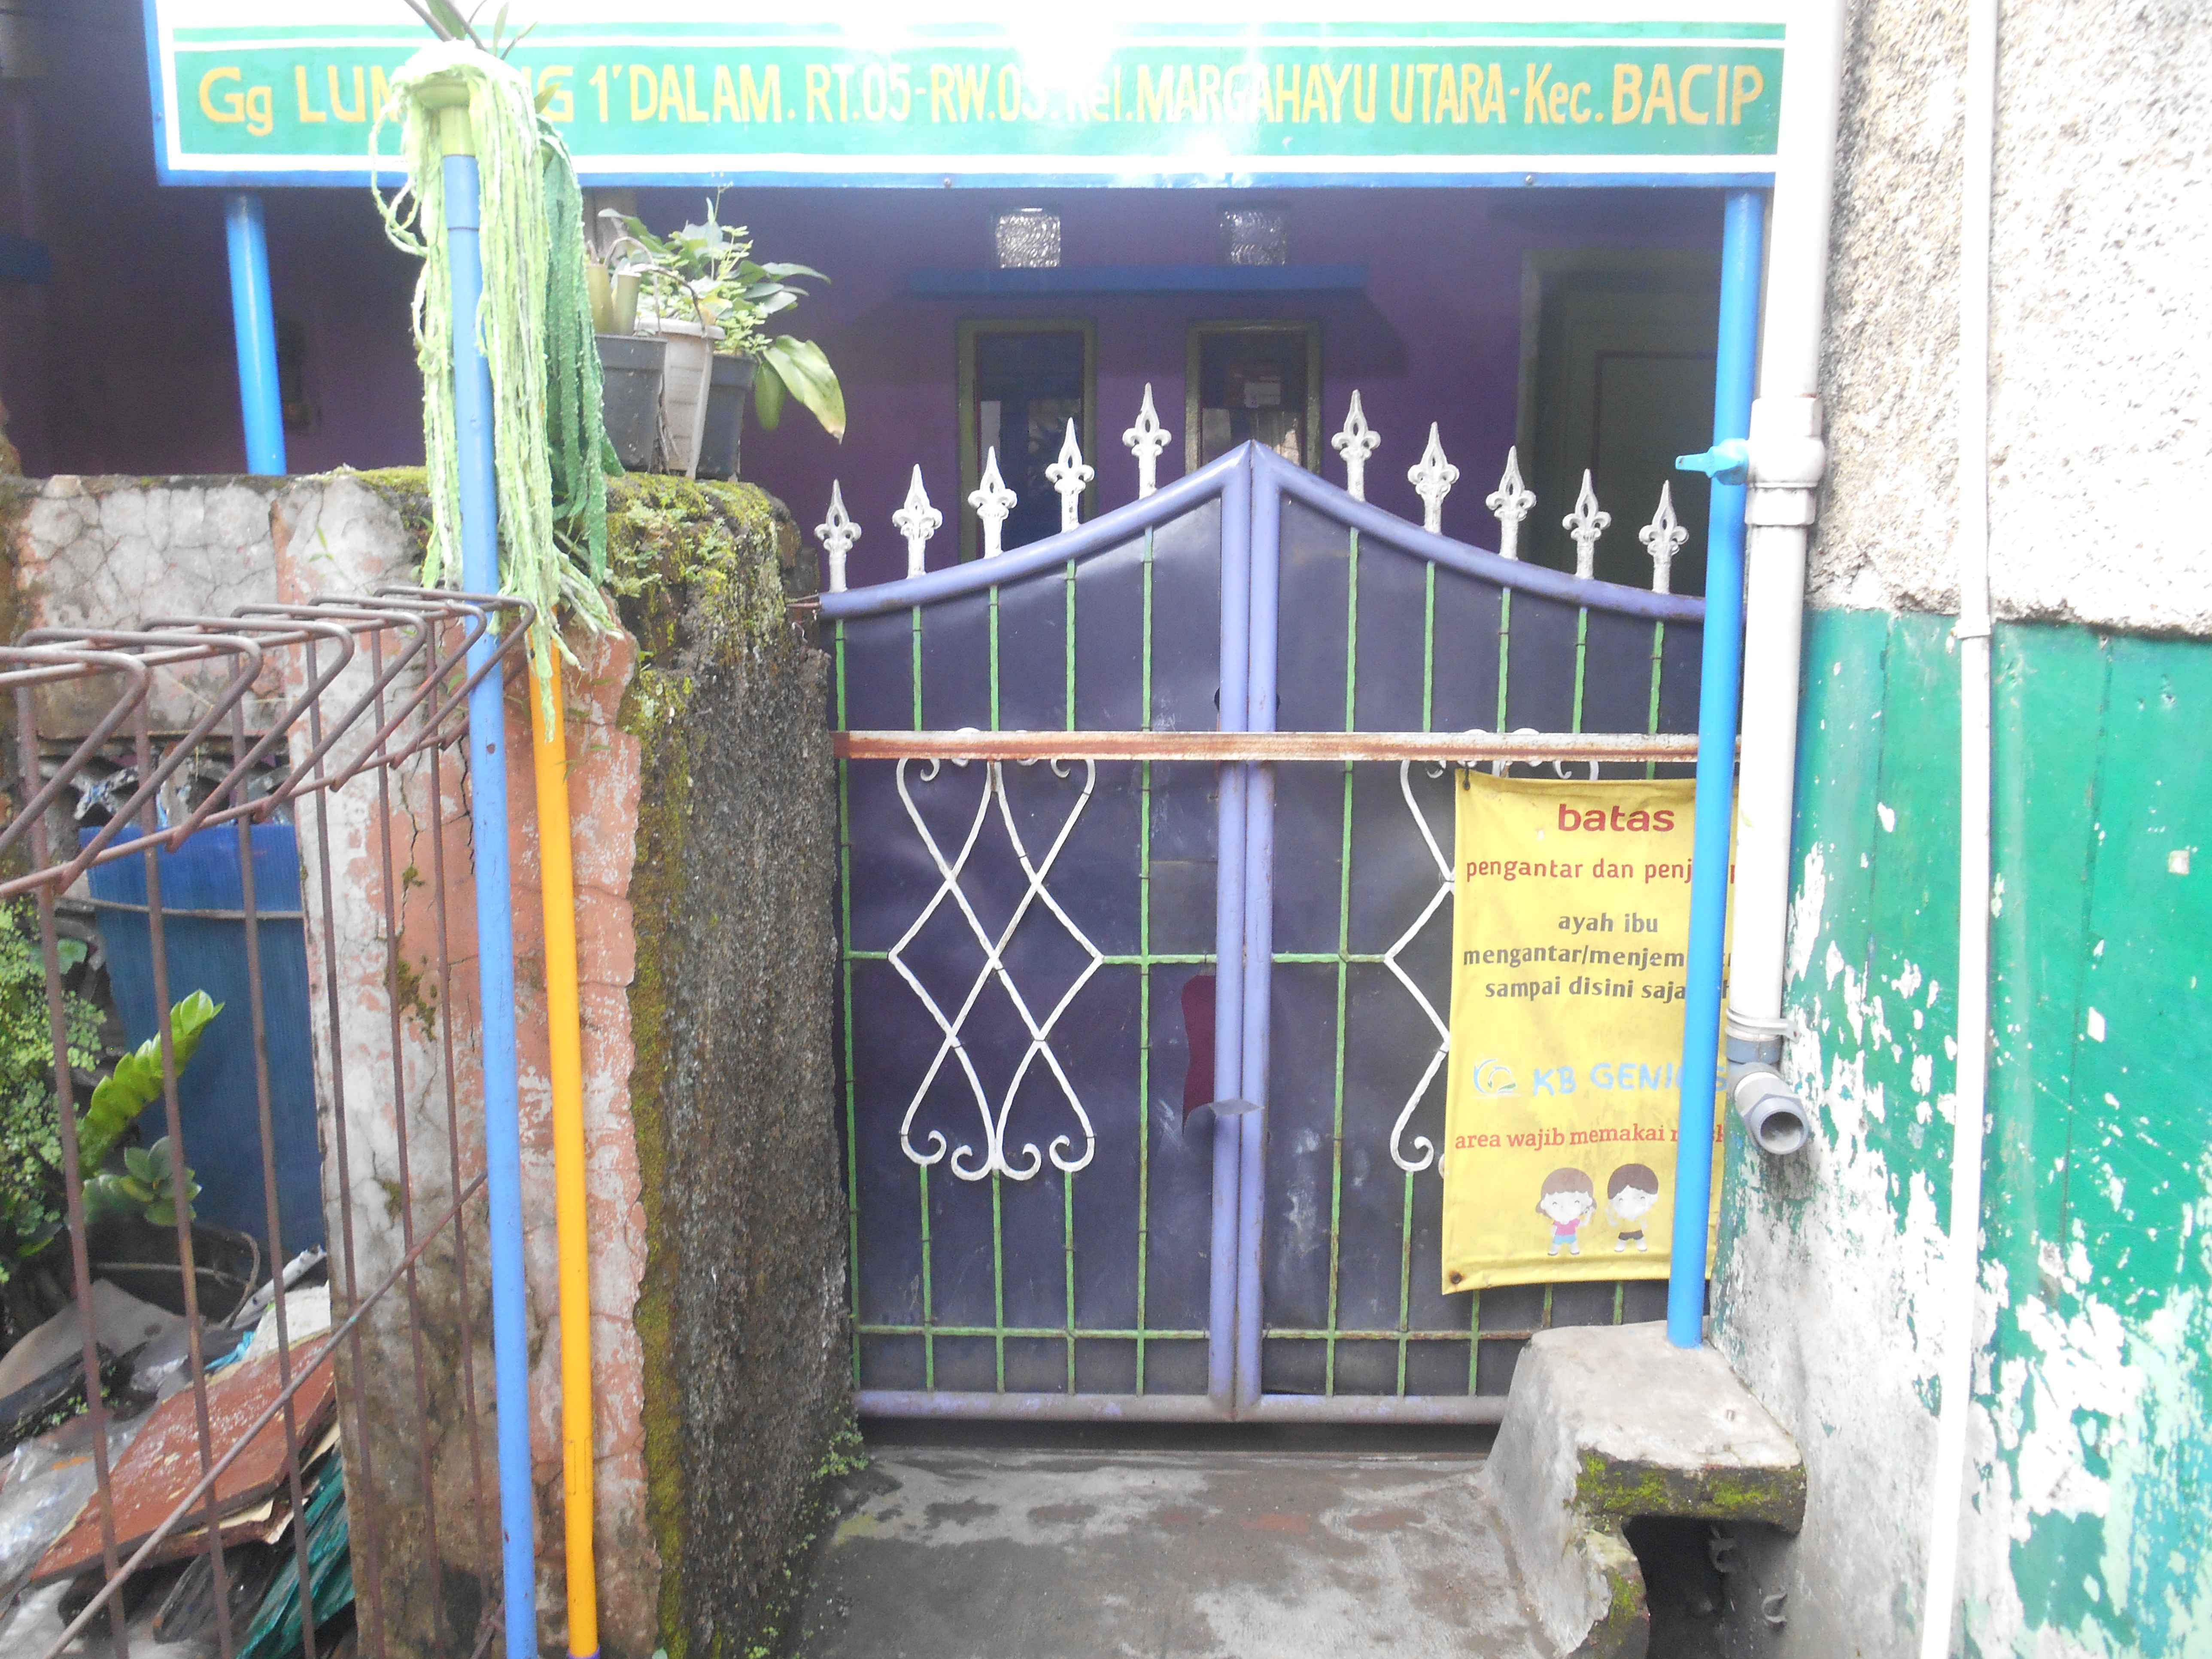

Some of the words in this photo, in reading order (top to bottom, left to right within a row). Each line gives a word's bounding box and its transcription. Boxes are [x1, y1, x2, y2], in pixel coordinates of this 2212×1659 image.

[199, 67, 273, 137] Gg
[1612, 64, 1764, 125] BACIP
[1558, 804, 1675, 832] batas
[1467, 860, 1583, 882] pengantar
[1592, 858, 1633, 878] dan
[1558, 913, 1613, 934] ayah
[1624, 913, 1658, 933] ibu
[1485, 976, 1561, 1001] sampai
[1569, 977, 1633, 998] disini
[1532, 1066, 1577, 1096] KB
[1455, 1133, 1501, 1149] area
[1506, 1127, 1565, 1151] wajib
[1570, 1124, 1665, 1146] memakai
